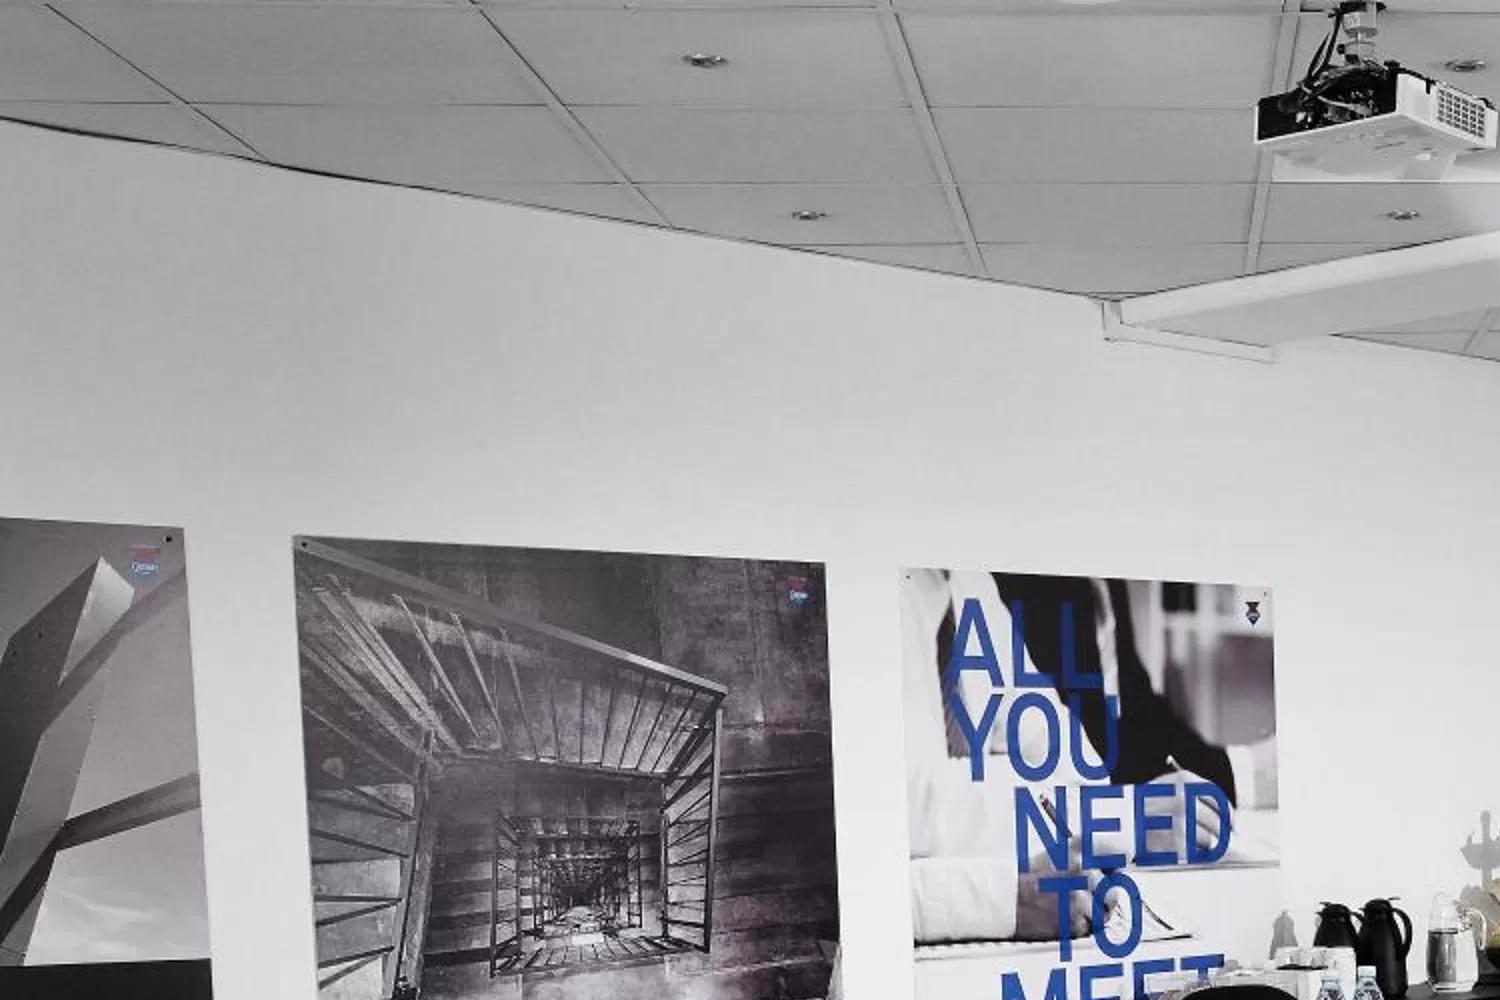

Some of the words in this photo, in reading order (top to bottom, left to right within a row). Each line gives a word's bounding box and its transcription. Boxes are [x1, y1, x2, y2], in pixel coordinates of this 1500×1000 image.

[947, 598, 1105, 689] ALL
[949, 692, 1120, 782] YOU
[1014, 782, 1232, 874] NEED
[1038, 872, 1143, 962] TO
